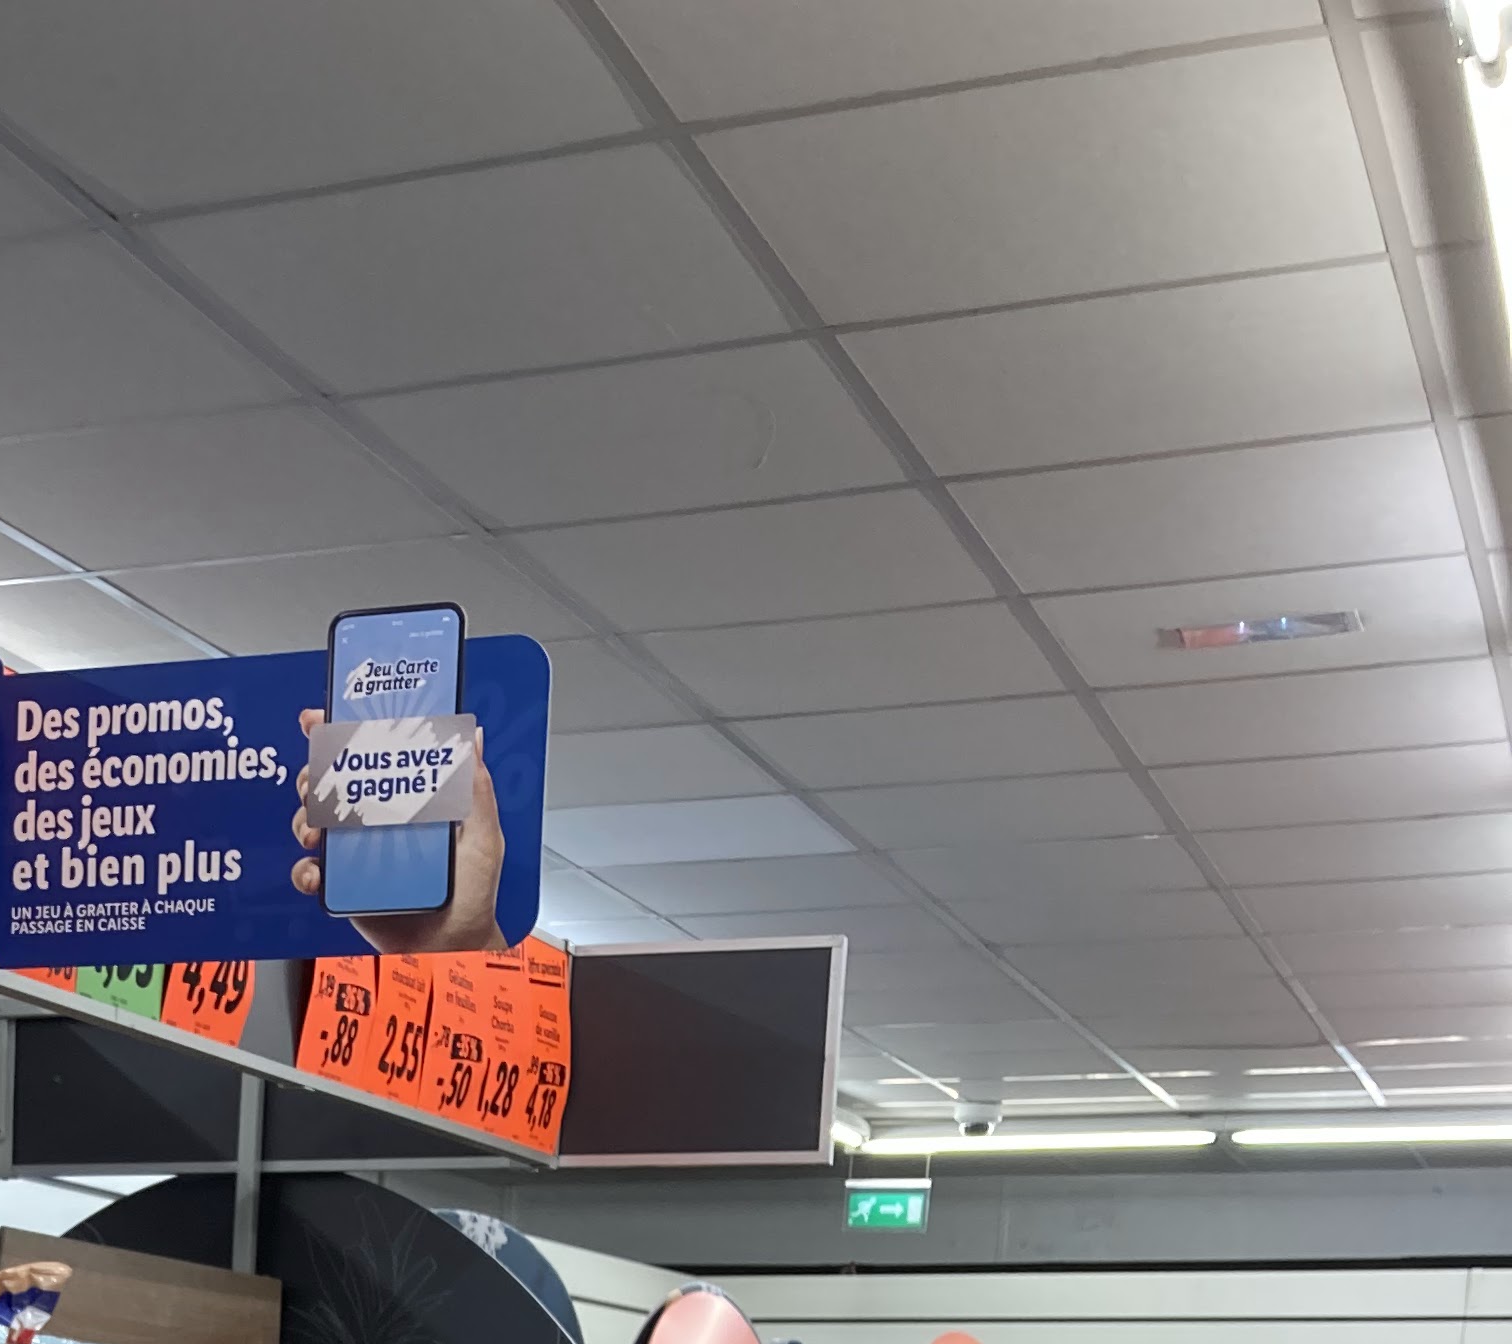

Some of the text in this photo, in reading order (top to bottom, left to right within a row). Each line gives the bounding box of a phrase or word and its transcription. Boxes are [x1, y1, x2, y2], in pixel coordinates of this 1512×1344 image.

[354, 673, 421, 696] à gratter
[364, 656, 440, 680] Jeu Carte
[16, 696, 235, 749] Des promos,
[14, 750, 78, 794] des
[82, 736, 289, 790] économies,
[332, 746, 455, 775] Vous avez
[13, 795, 157, 852] des jeux
[11, 839, 243, 896] et bien plus
[10, 916, 147, 936] PASSAGE EN CAISSE
[11, 897, 216, 922] UN JEU À GRATTER À CHAQUE
[182, 961, 249, 1014] 4,49
[377, 1013, 424, 1085] 2,55
